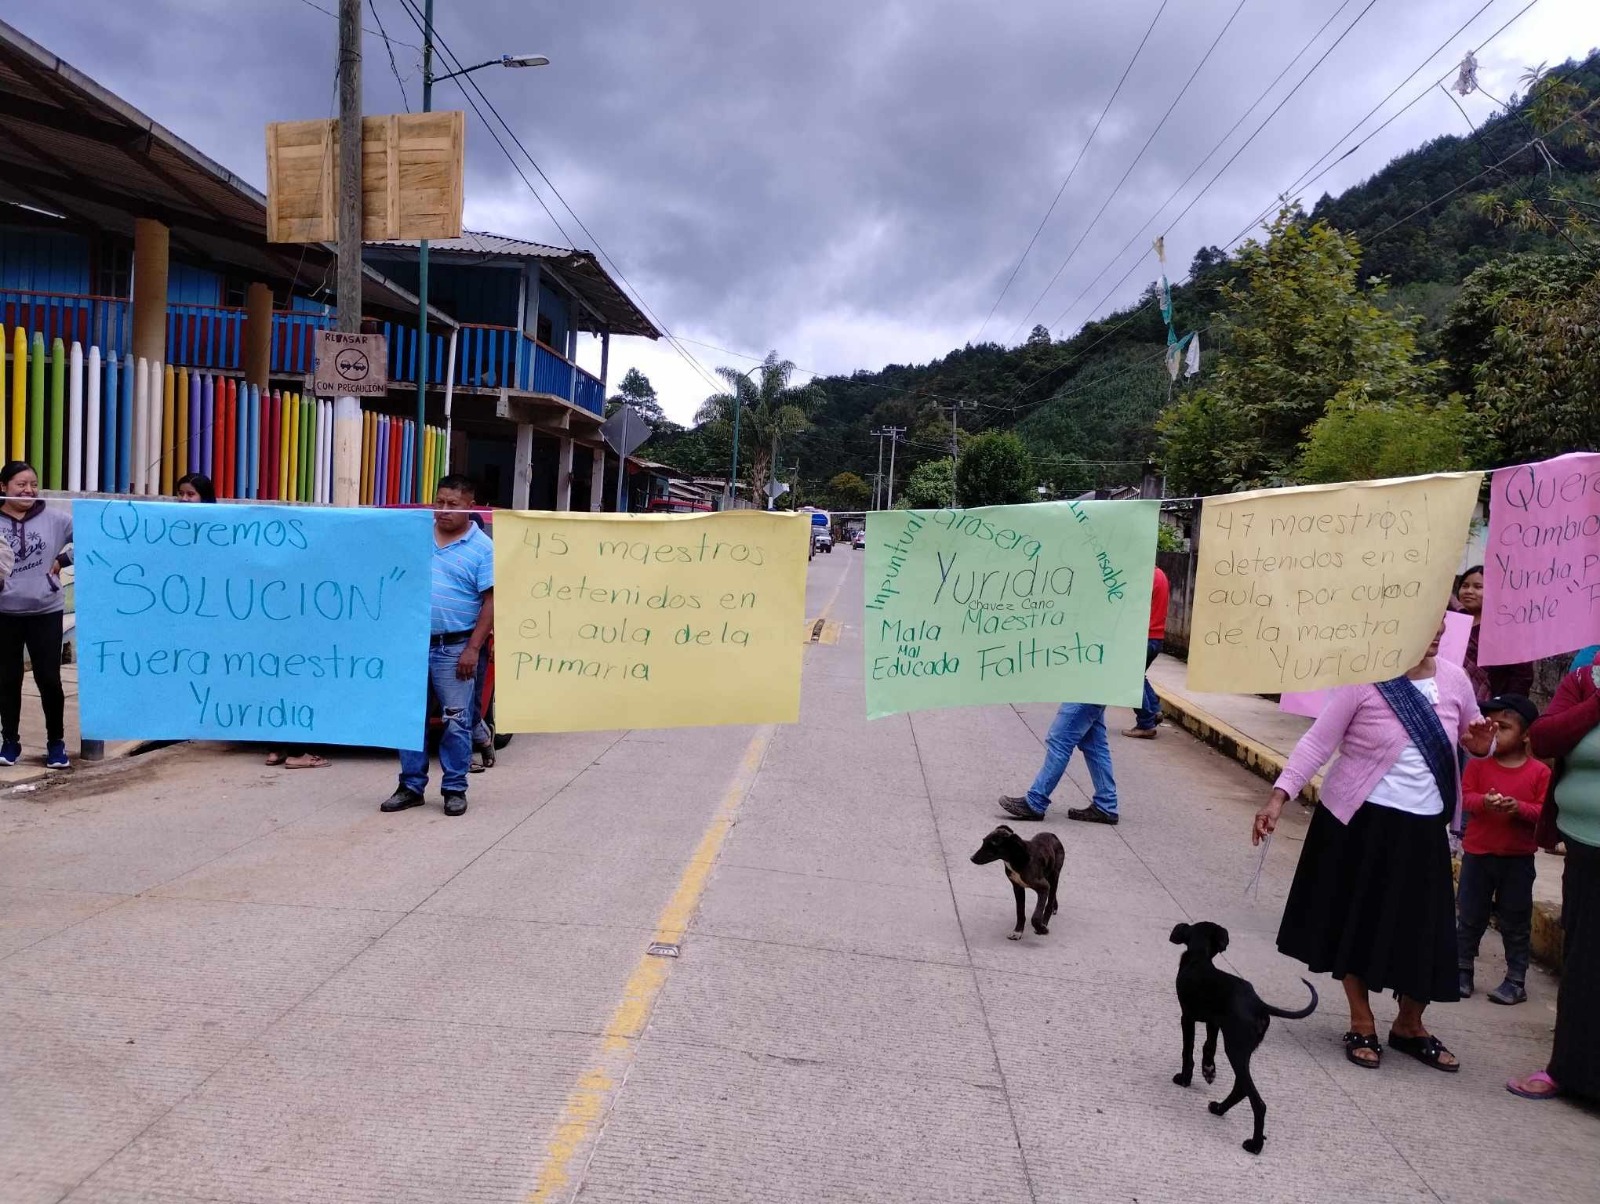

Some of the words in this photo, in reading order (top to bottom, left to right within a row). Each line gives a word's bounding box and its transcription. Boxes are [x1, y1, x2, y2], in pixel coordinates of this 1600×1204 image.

[317, 381, 334, 391] CON
[100, 500, 308, 549] Queremos
[1216, 511, 1256, 540] 47
[523, 527, 568, 559] 45
[599, 532, 764, 566] maestros
[1214, 547, 1344, 577] detenidos
[933, 552, 1075, 605] Yuridia
[1495, 552, 1572, 591] Yuridia
[530, 575, 702, 610] detenidos
[719, 591, 756, 609] en
[1021, 598, 1055, 610] Cano
[1297, 588, 1340, 615] por
[518, 611, 553, 639] el
[577, 618, 651, 645] aula
[881, 619, 941, 642] Mala
[961, 608, 1066, 635] Maestra
[1204, 622, 1243, 647] de
[1256, 616, 1280, 642] la
[1298, 612, 1400, 642] maestra
[92, 640, 209, 678] Fuera
[225, 644, 385, 680] maestra
[872, 651, 961, 681] Educada
[977, 631, 1105, 682] Faltista
[898, 644, 921, 659] Mal
[1270, 641, 1402, 684] Yuridia
[189, 681, 315, 731] Yuridia
